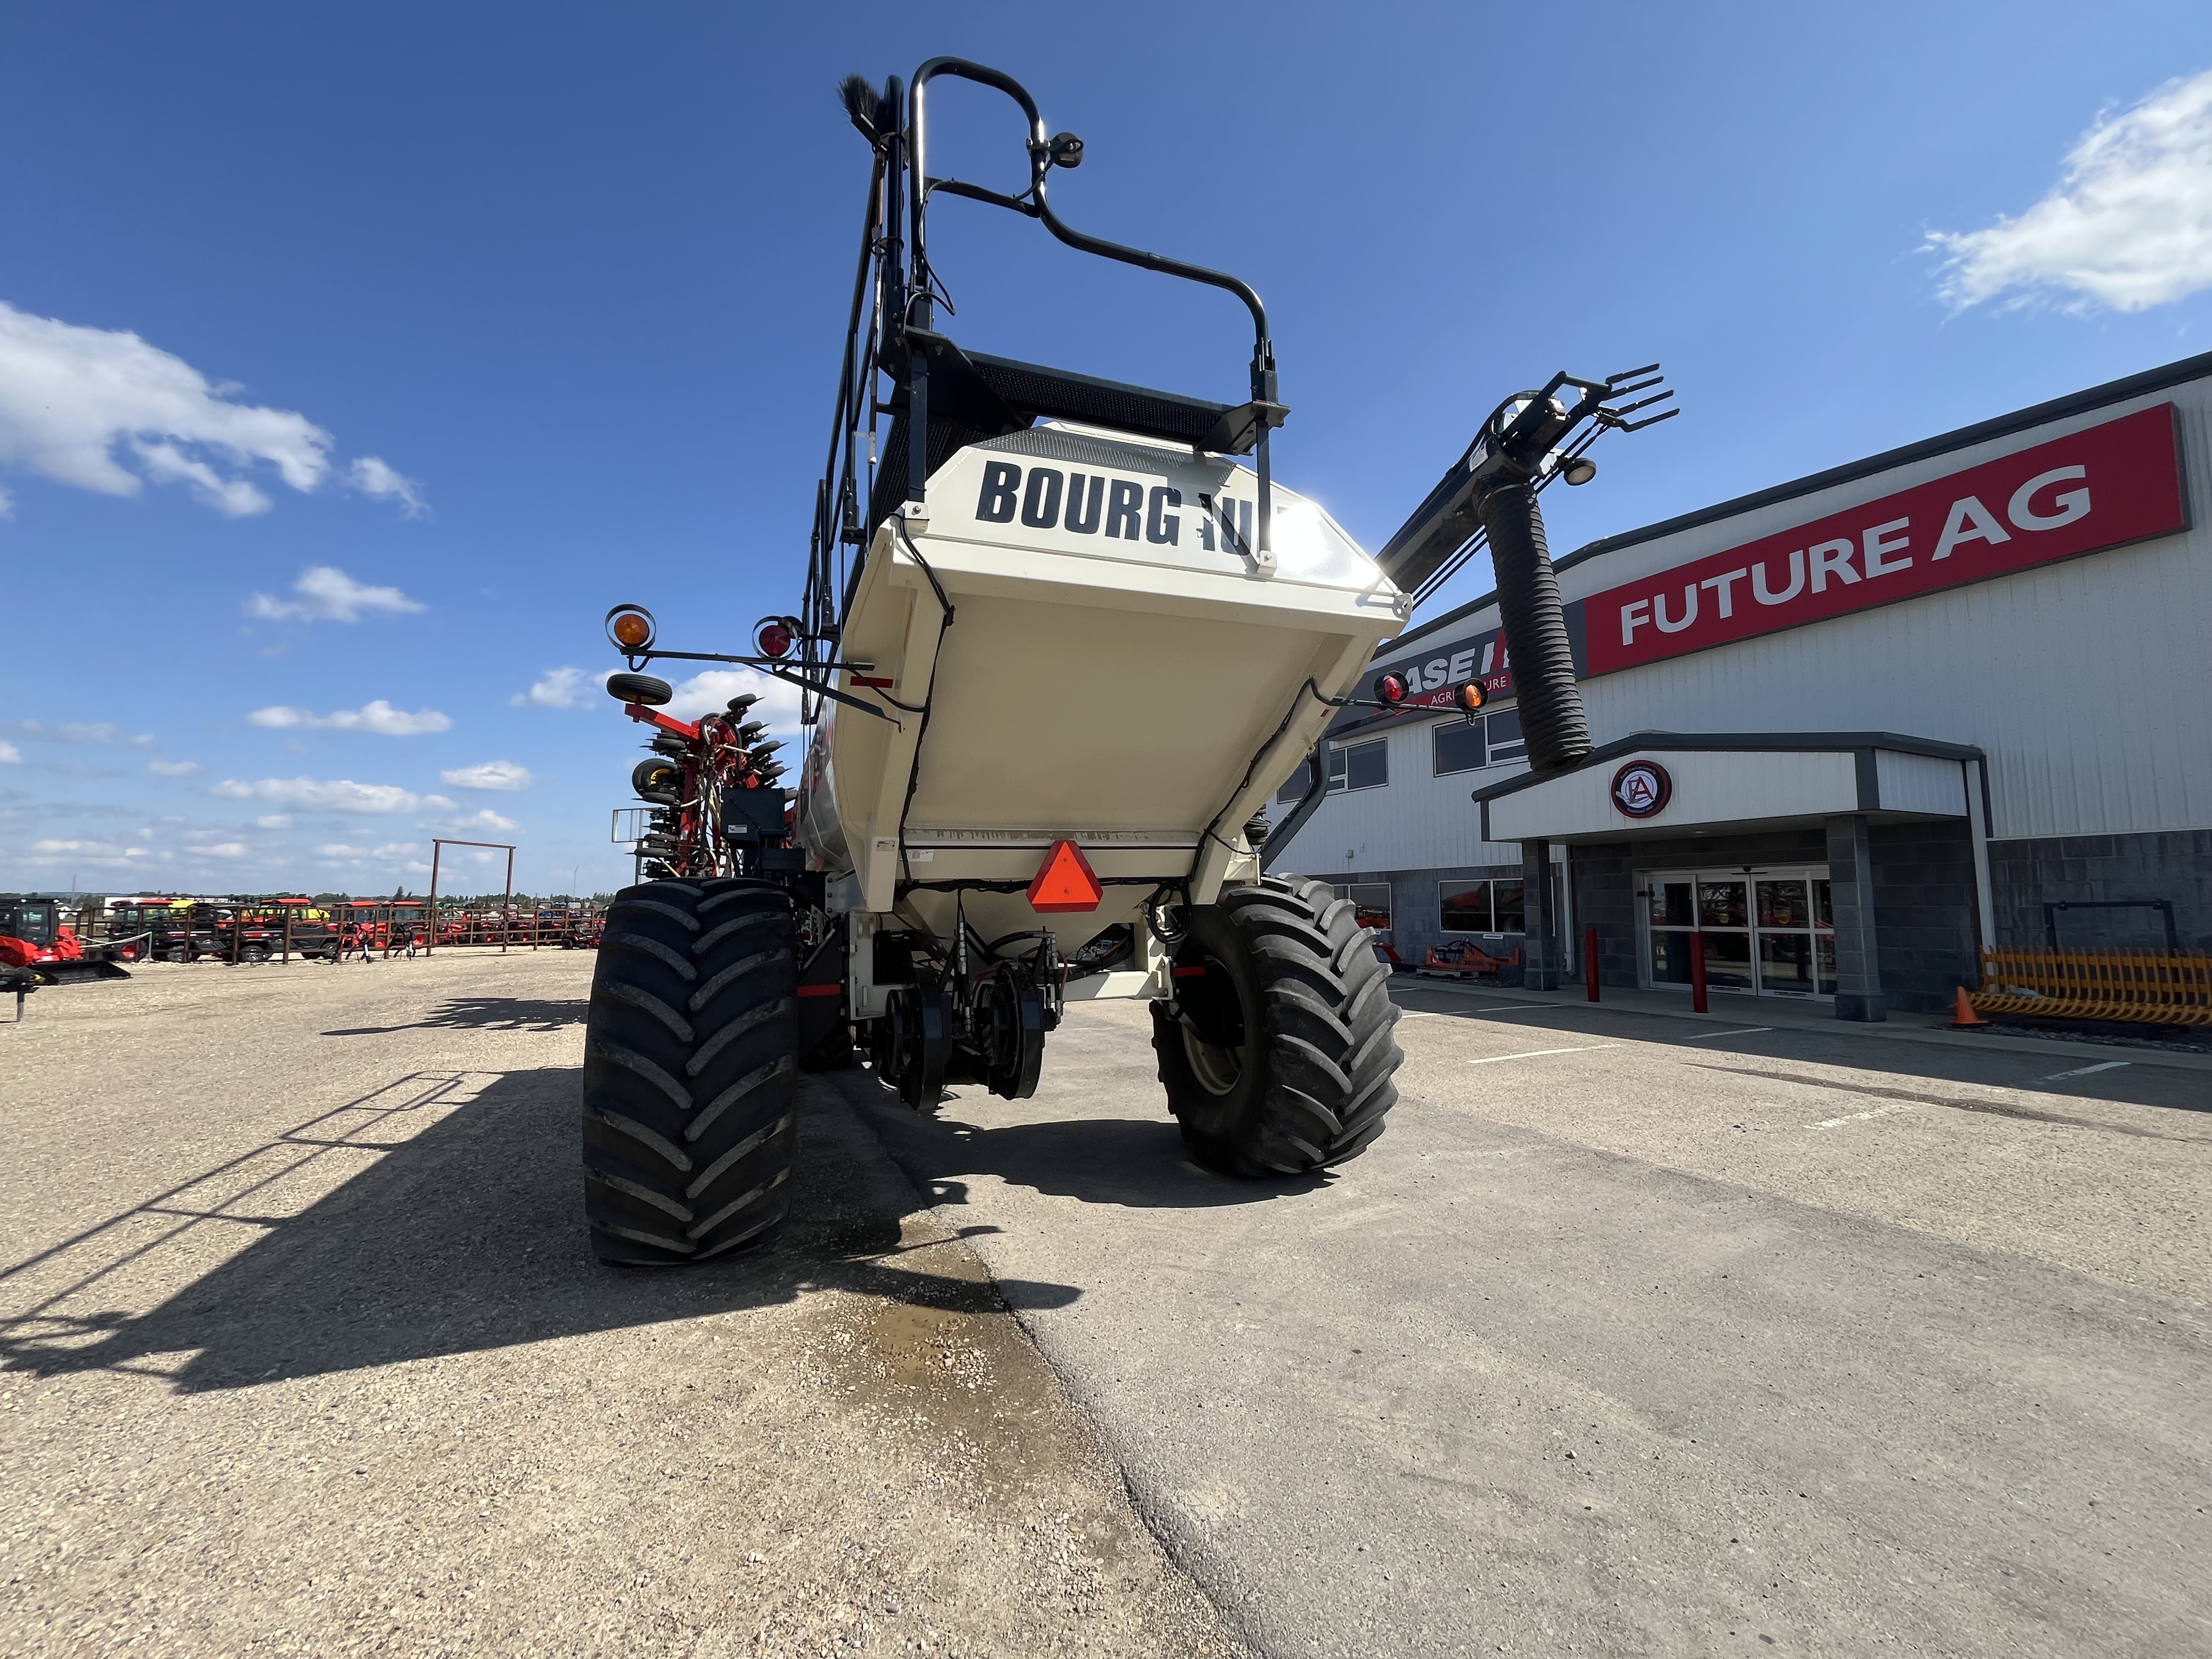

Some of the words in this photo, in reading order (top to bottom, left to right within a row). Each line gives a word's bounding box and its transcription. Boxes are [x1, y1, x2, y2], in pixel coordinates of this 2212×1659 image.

[975, 460, 1290, 556] BOURGU
[1621, 517, 1913, 646] FUTURE
[1932, 465, 2091, 561] AG
[1383, 647, 1476, 694] ASE
[1431, 676, 1506, 706] AGRIURE
